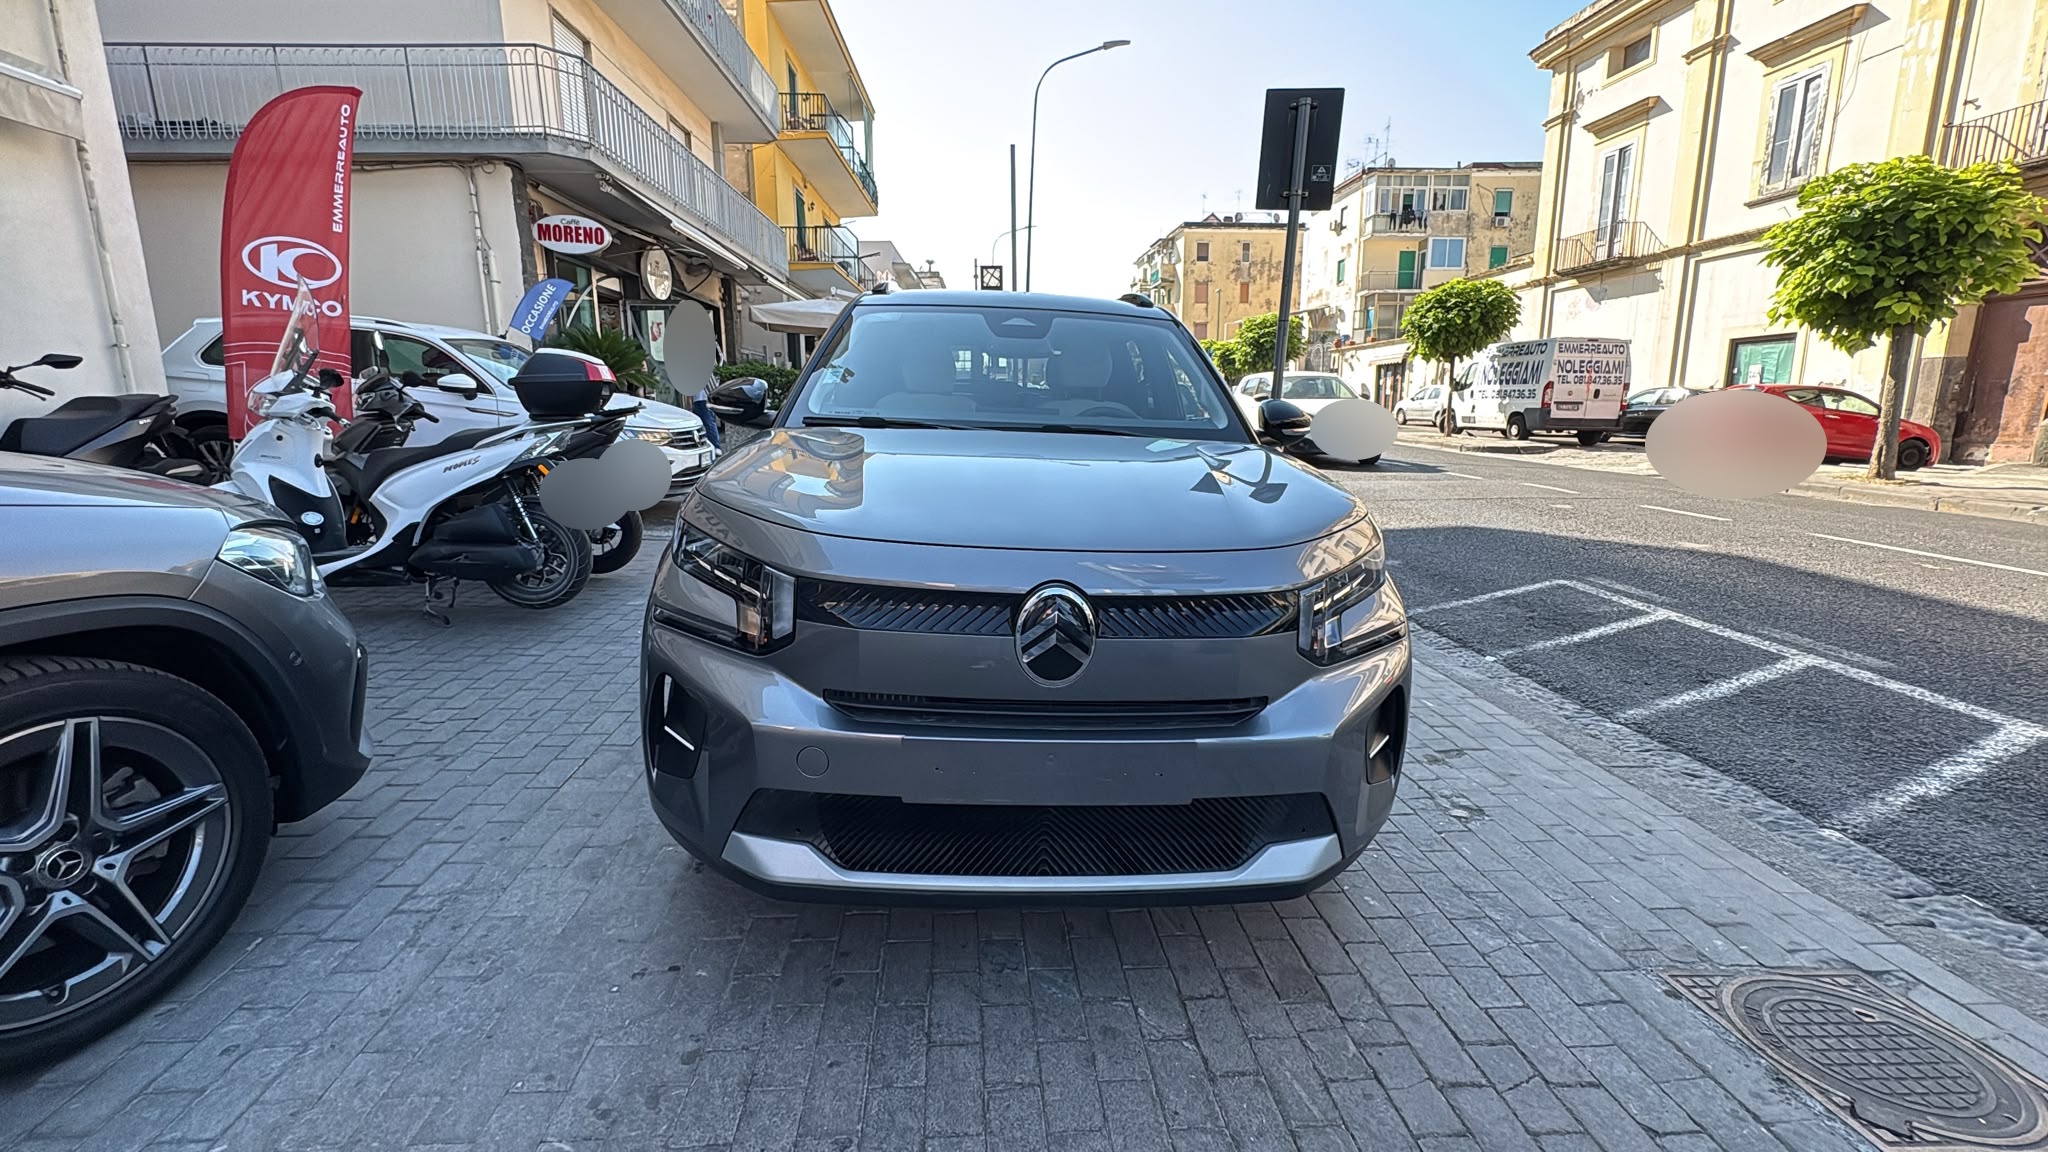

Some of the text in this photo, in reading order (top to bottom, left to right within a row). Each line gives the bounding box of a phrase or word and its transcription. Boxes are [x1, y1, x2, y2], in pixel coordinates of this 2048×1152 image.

[332, 104, 351, 233] EMMERREAUTO
[537, 223, 605, 245] MORENO
[241, 289, 343, 317] KYMCO
[521, 283, 557, 334] OCCASIONE
[1558, 343, 1626, 355] EMMERREAUTO
[1557, 360, 1624, 374] NOLEGGIAMI
[1557, 375, 1571, 384] TEL.
